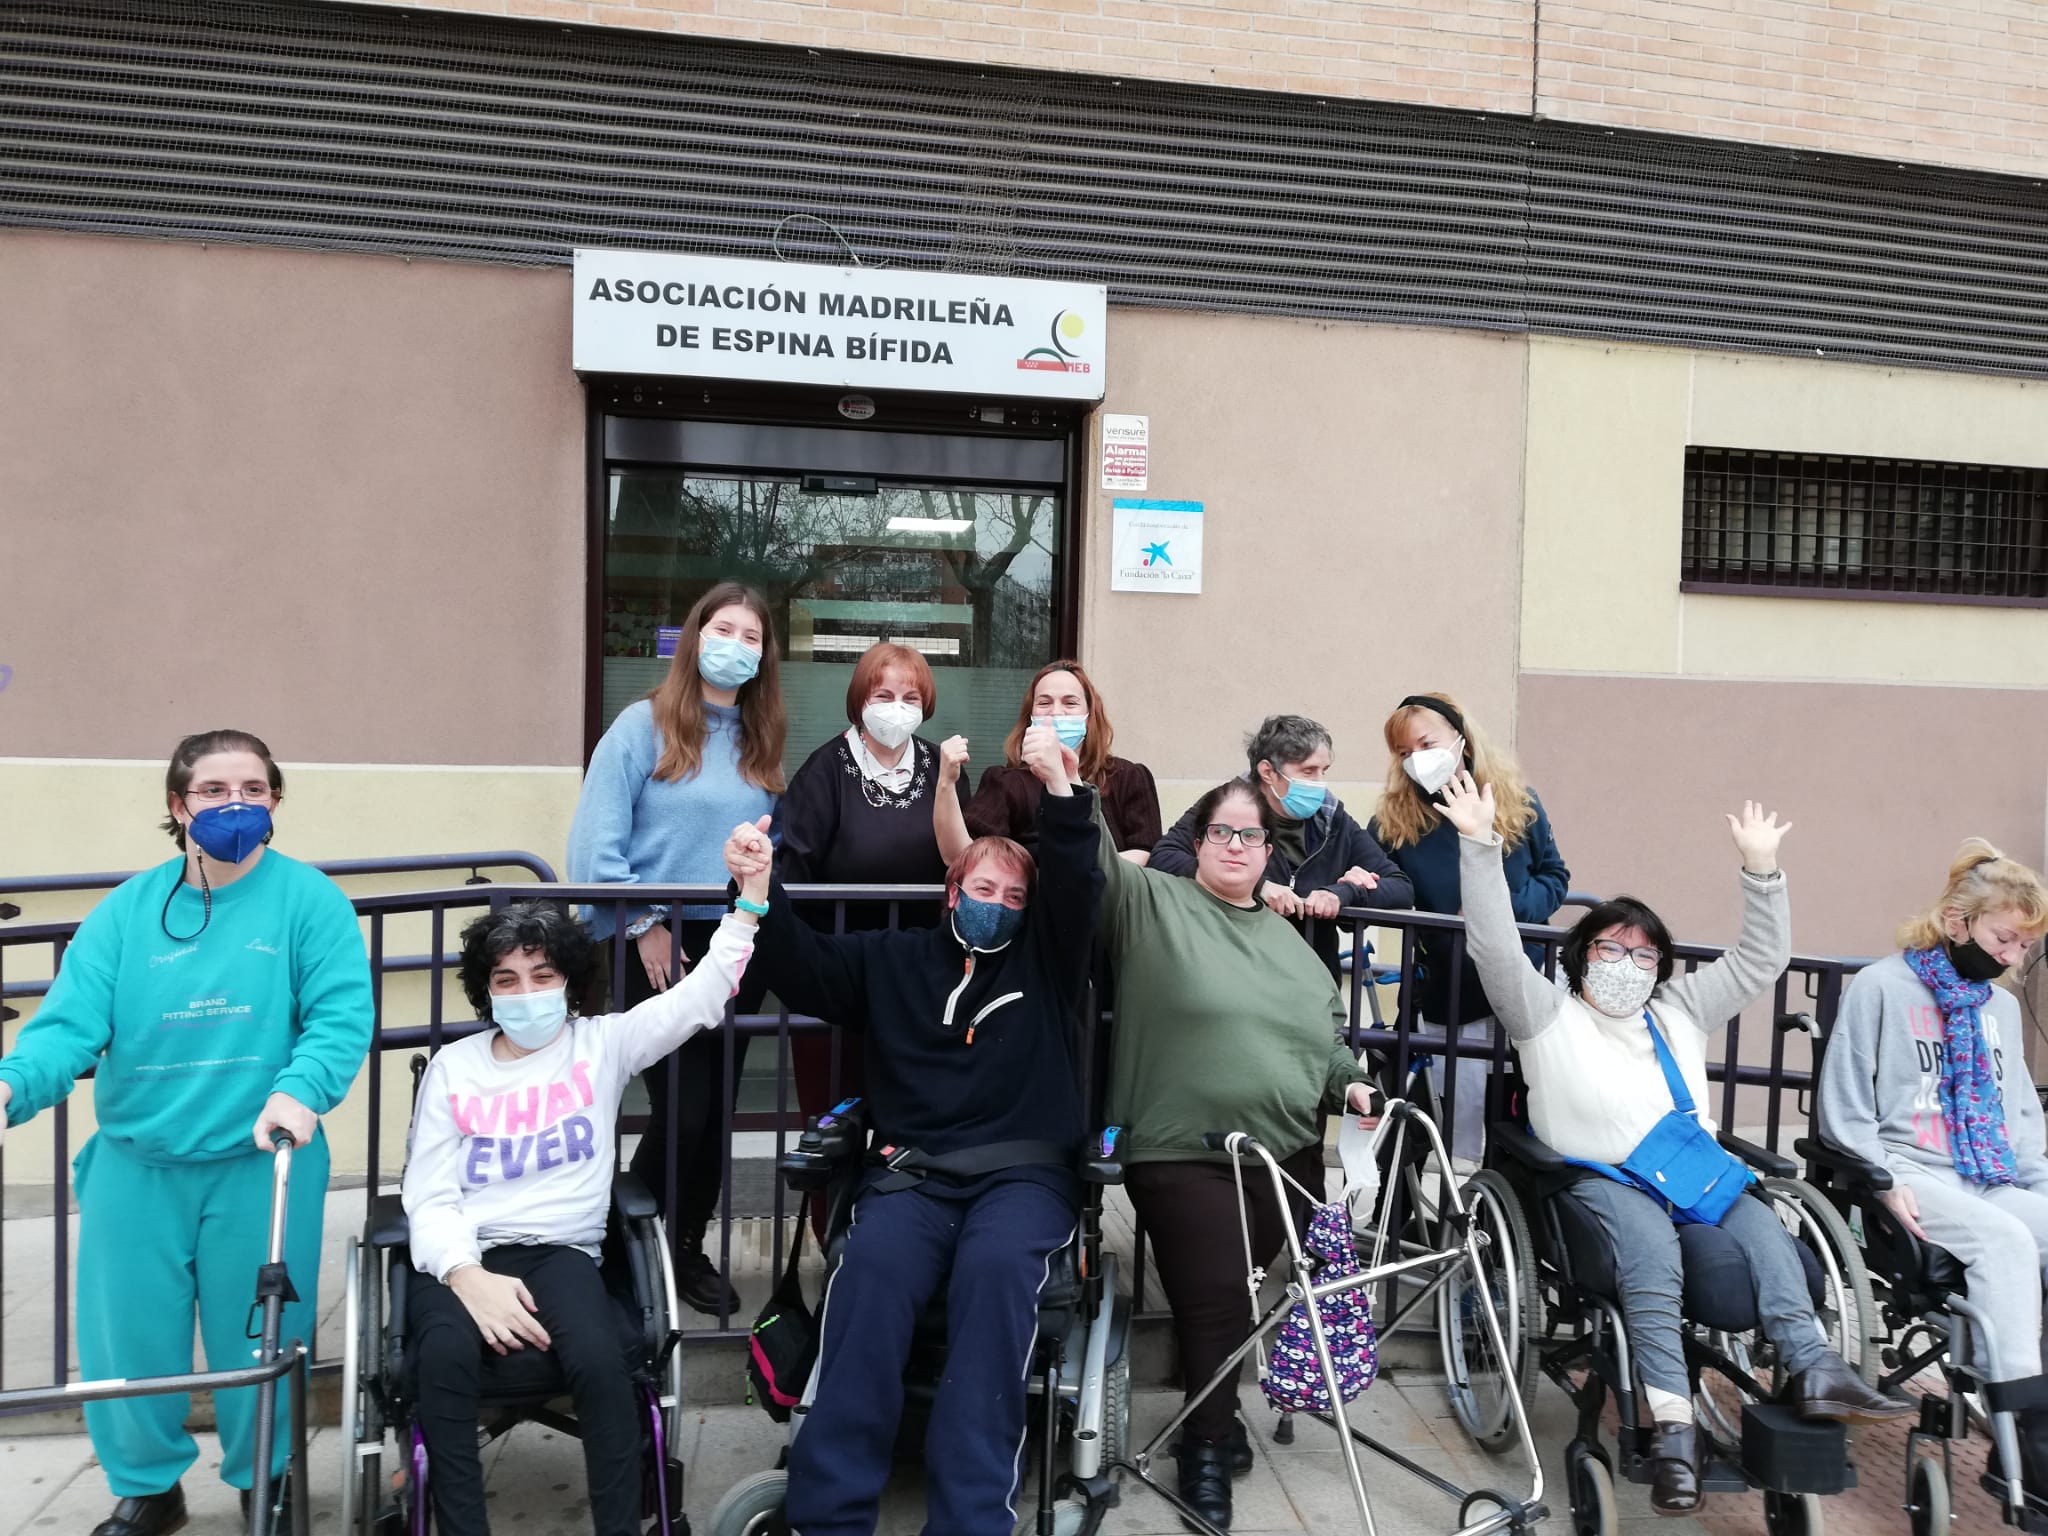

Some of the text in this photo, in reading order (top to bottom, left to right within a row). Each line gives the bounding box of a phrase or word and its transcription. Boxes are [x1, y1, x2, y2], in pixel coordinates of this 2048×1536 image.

[589, 278, 1014, 327] ASOCIACIÓN MADRILEÑA
[656, 324, 954, 365] DE ESPINA BÍFIDA
[1106, 426, 1146, 437] verisure
[1105, 445, 1146, 456] Alarma
[188, 998, 227, 1009] BRAND
[162, 1005, 252, 1020] FITTING SERVICE
[466, 1115, 596, 1185] EVER
